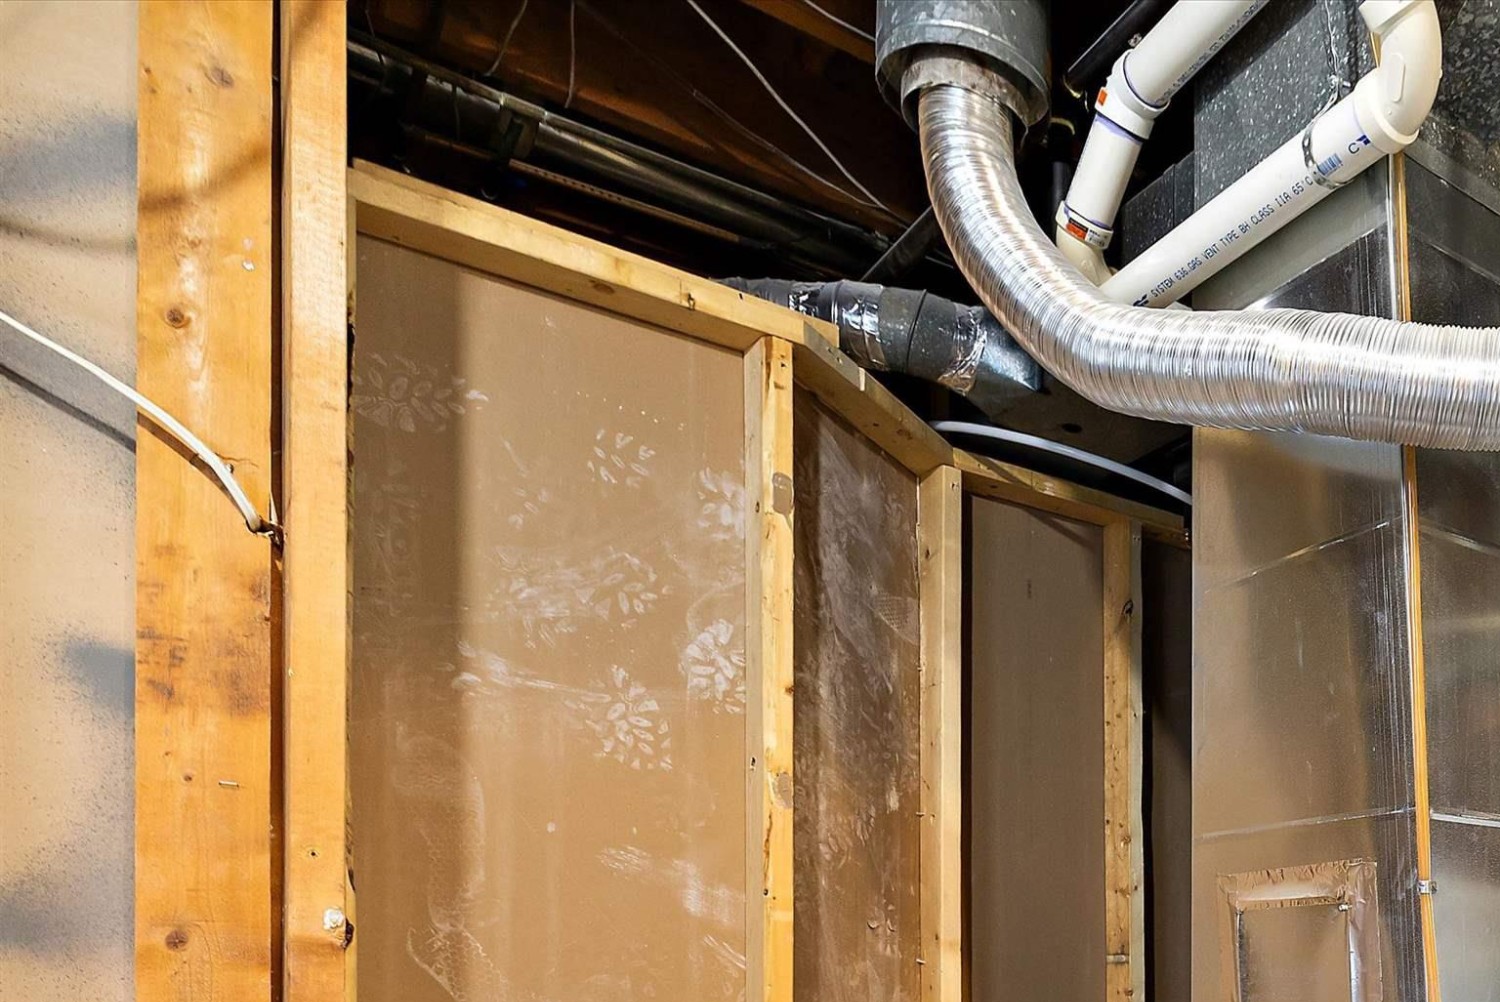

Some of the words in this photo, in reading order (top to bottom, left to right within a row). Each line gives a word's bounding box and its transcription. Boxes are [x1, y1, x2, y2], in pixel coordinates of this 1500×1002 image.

[1151, 277, 1175, 297] SYSTEM
[1201, 244, 1220, 260] VENT
[1219, 230, 1239, 246] TYPE
[1238, 221, 1251, 234] BH
[1250, 204, 1275, 225] CLASS
[1275, 191, 1292, 207] IIA
